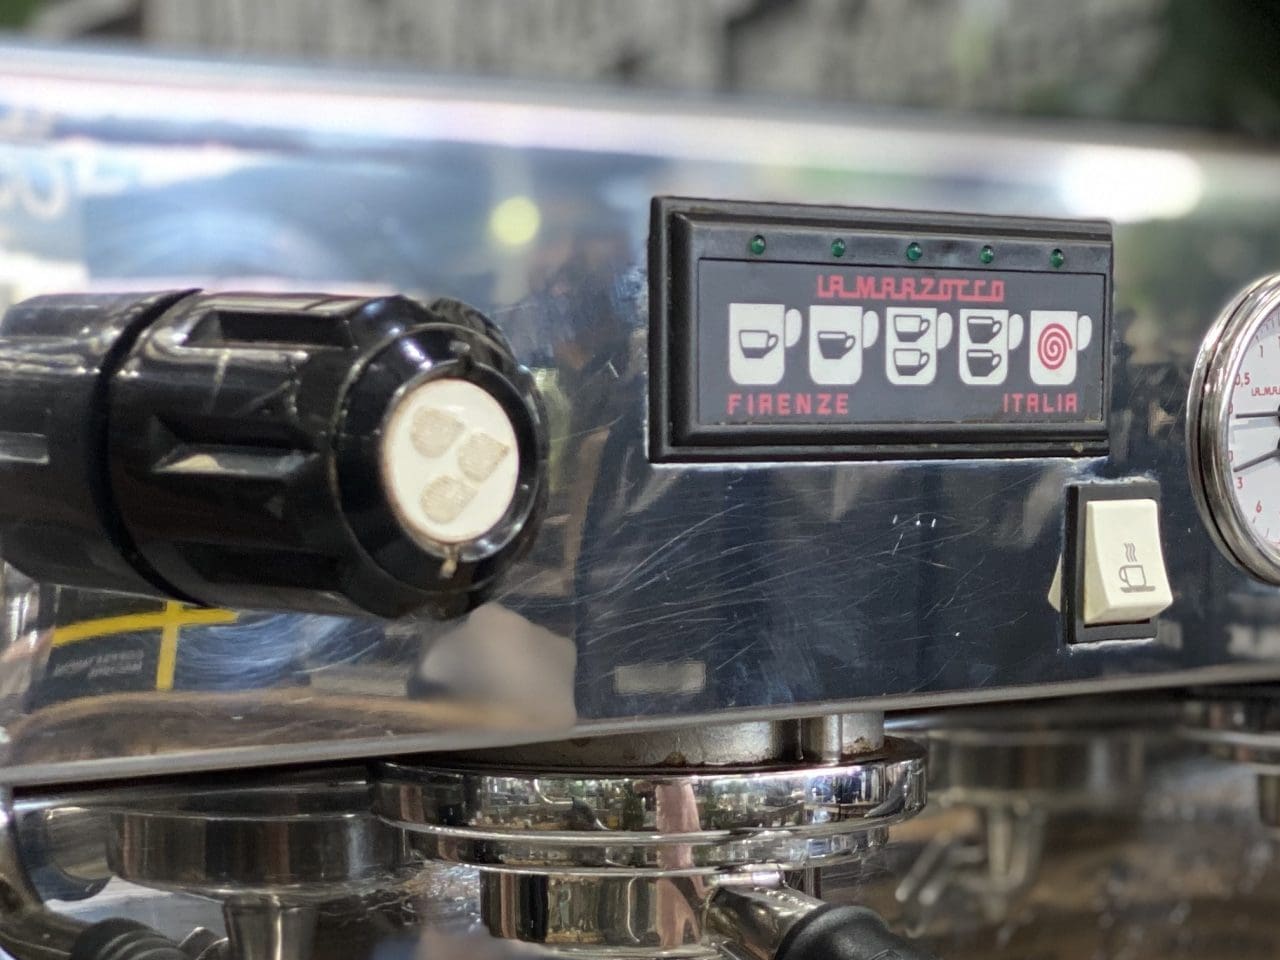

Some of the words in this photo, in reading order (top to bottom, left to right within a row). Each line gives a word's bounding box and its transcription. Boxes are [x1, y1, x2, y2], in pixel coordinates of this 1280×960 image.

[1259, 346, 1264, 358] 1
[726, 393, 849, 415] FIRENZE
[1003, 393, 1077, 414] ITALIA
[1237, 477, 1243, 489] 3
[1256, 500, 1262, 513] 6
